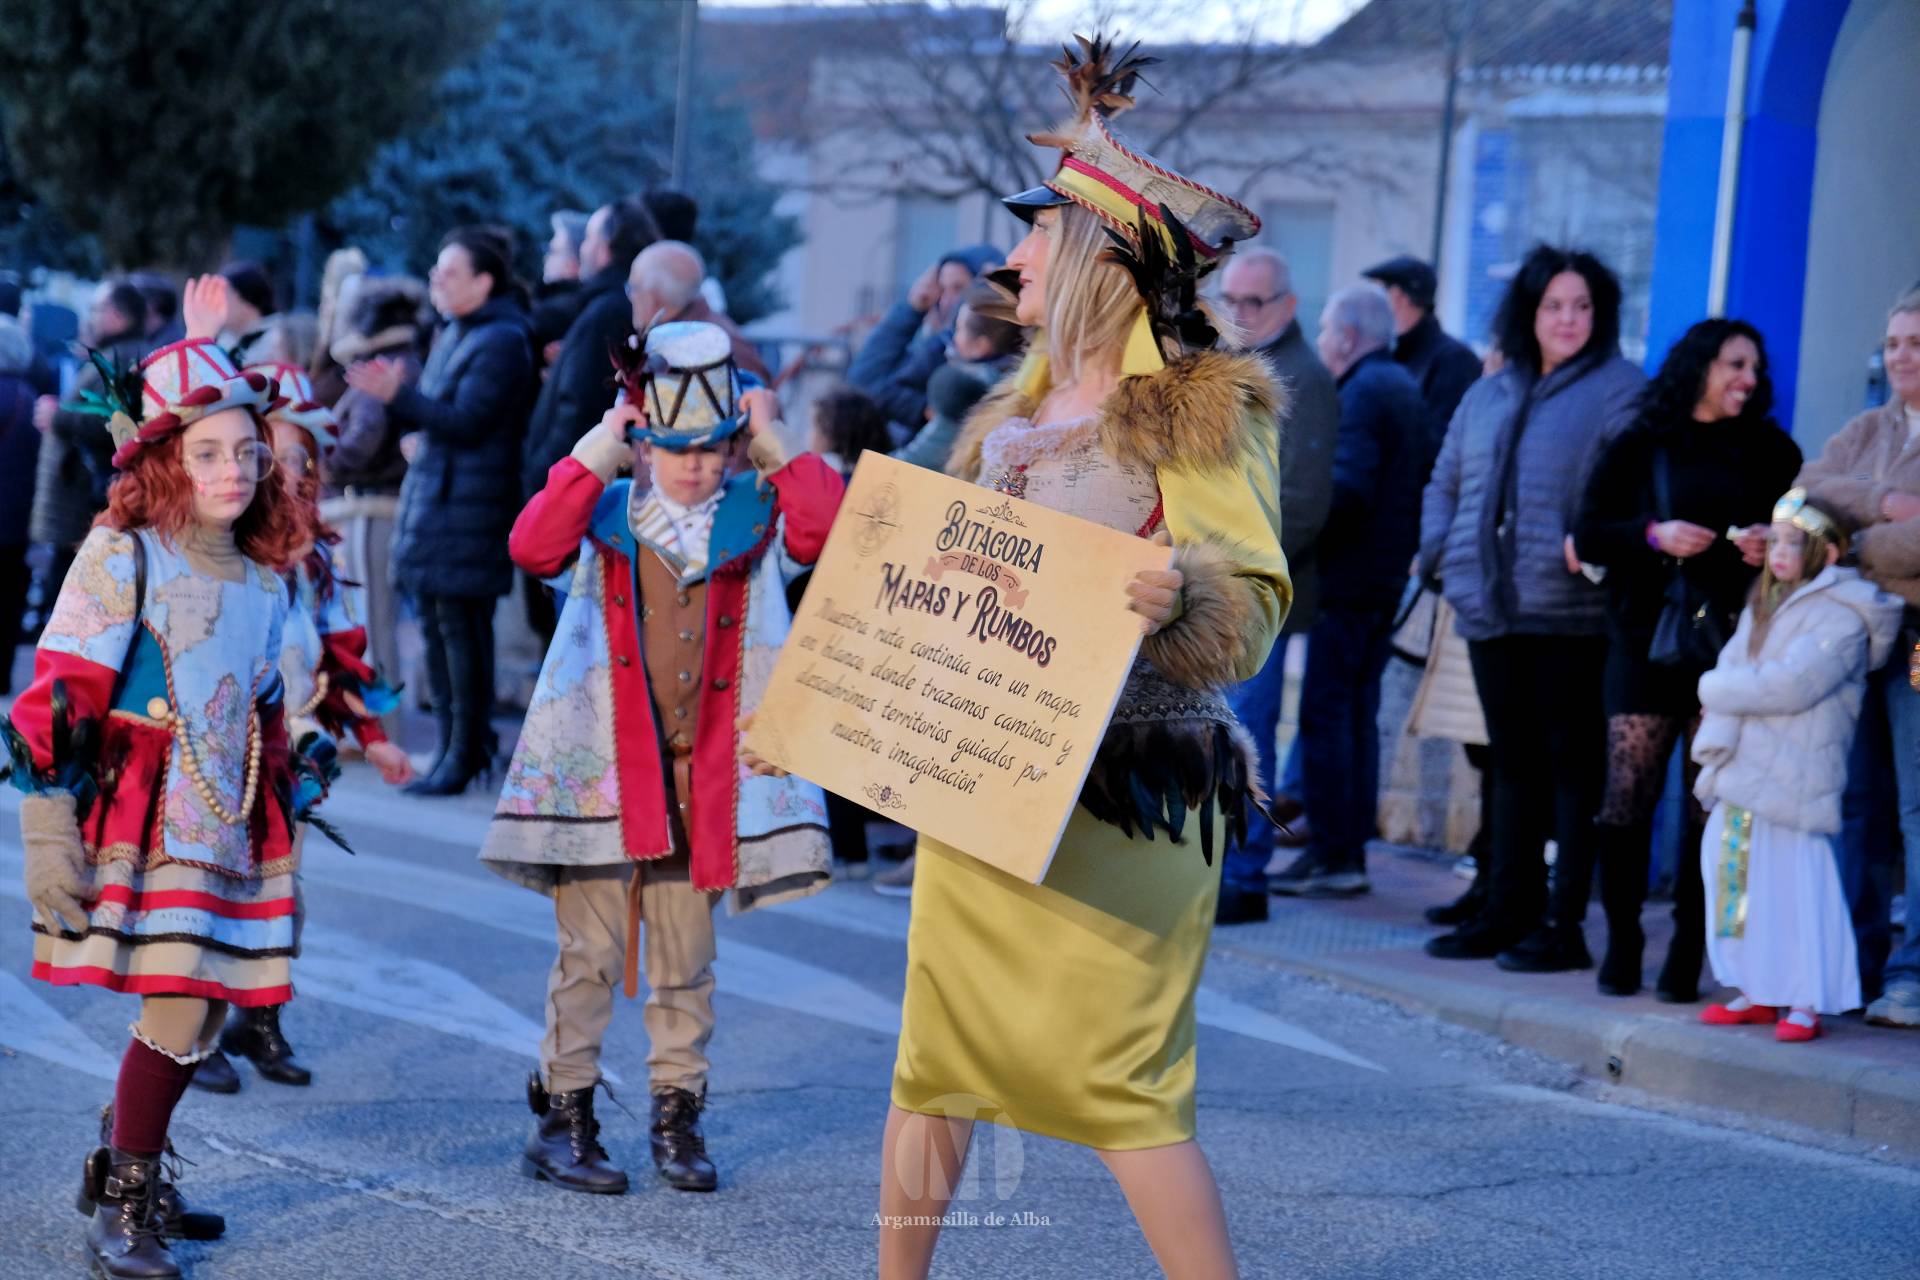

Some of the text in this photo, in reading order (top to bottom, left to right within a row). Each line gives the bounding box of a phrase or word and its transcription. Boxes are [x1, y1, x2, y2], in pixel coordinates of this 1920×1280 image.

[935, 500, 1045, 574] BITÁCORA
[960, 554, 1002, 582] DE LOS
[874, 561, 1057, 668] MAPAS Y RUMBOS
[869, 653, 917, 691] donde
[921, 676, 990, 720] trazamos
[993, 712, 1057, 748] caminos
[1055, 738, 1074, 766] y
[873, 626, 905, 649] ruta
[910, 640, 972, 676] continúa
[977, 667, 1004, 688] con
[1007, 678, 1031, 698] un
[1034, 688, 1083, 724] mapa
[829, 721, 985, 794] nuestra imaginación"
[880, 698, 953, 744] territorios
[950, 737, 1017, 771] guiados
[1013, 760, 1048, 787] por
